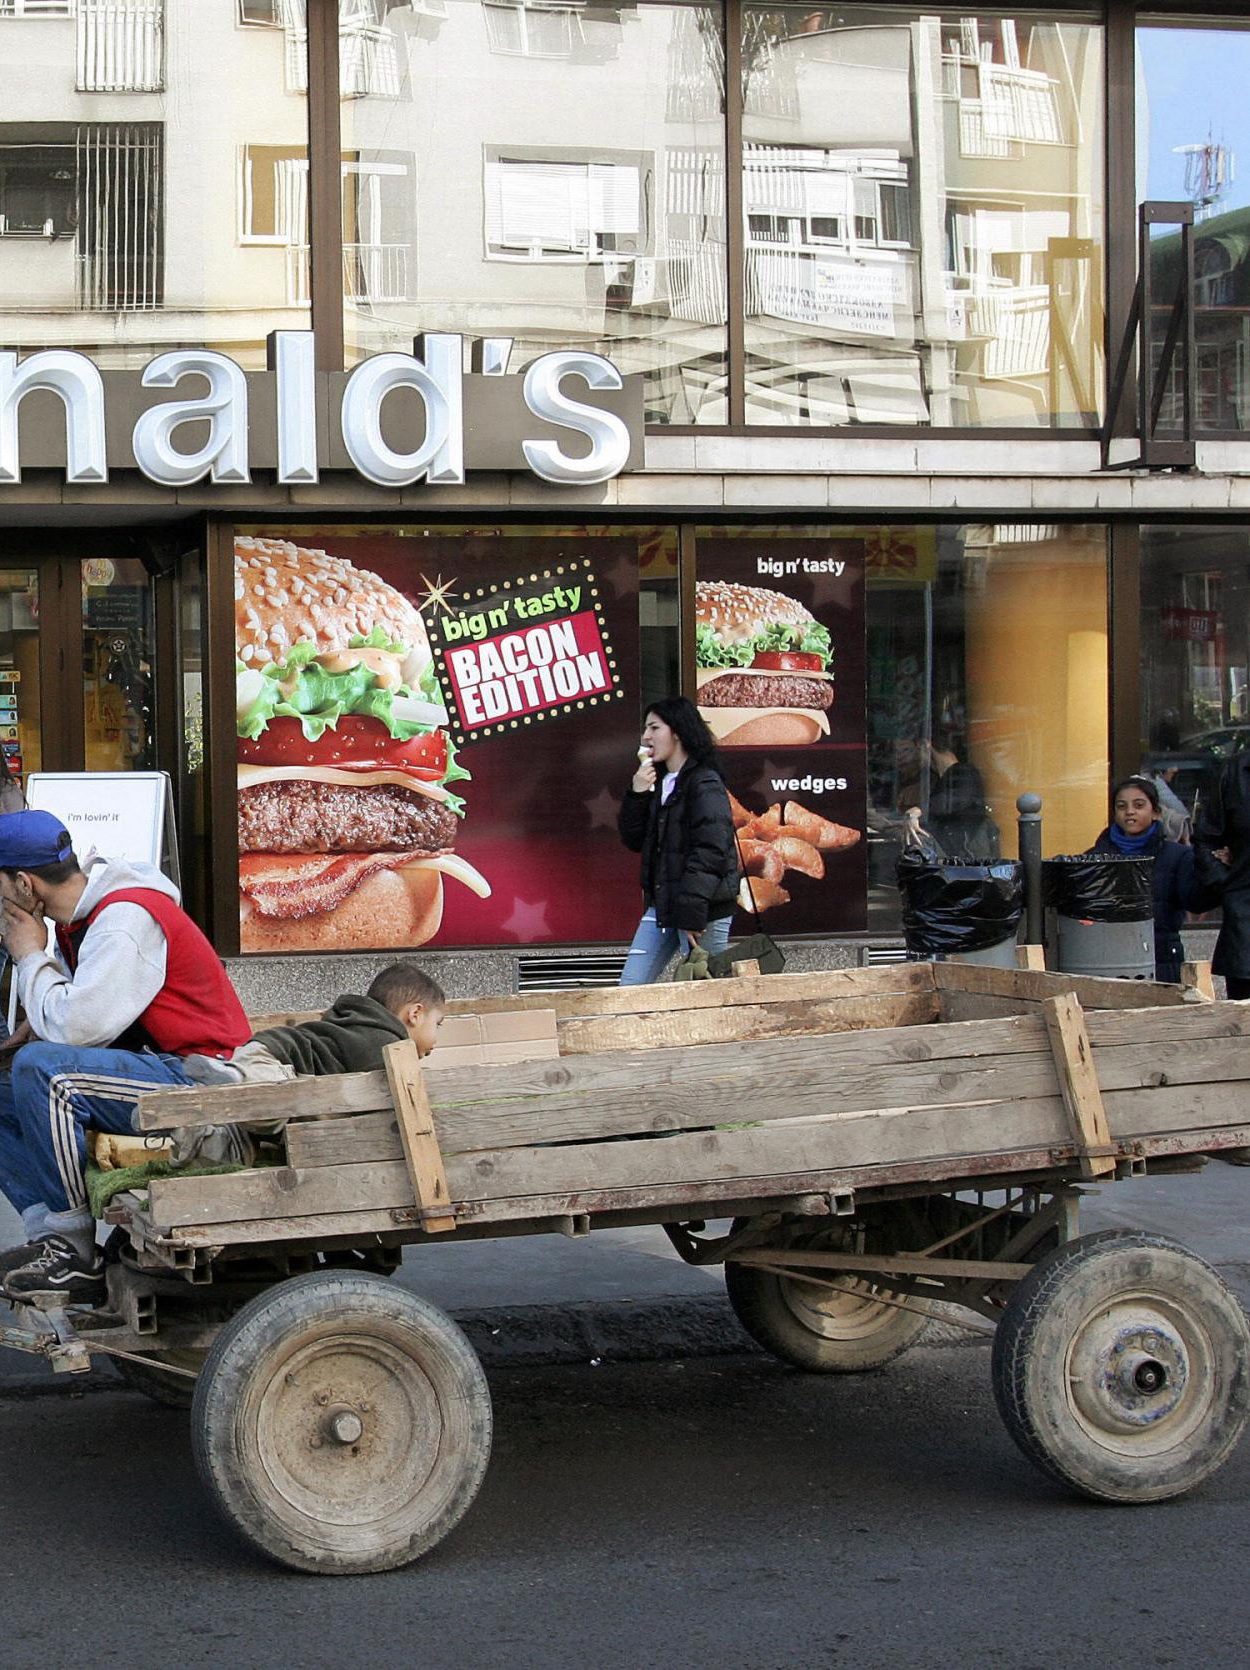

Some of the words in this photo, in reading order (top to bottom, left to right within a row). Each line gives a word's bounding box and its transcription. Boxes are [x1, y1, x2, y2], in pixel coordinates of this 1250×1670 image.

[757, 557, 784, 577] big
[786, 558, 801, 574] n'
[802, 557, 846, 577] tasty
[441, 611, 488, 642] big
[489, 600, 510, 629] n'
[513, 586, 582, 619] tasty
[450, 619, 579, 689] BACON
[460, 651, 607, 726] EDITION
[771, 774, 848, 794] wedges
[67, 813, 82, 822] i'm
[84, 813, 111, 822] lovin'
[112, 813, 119, 822] it
